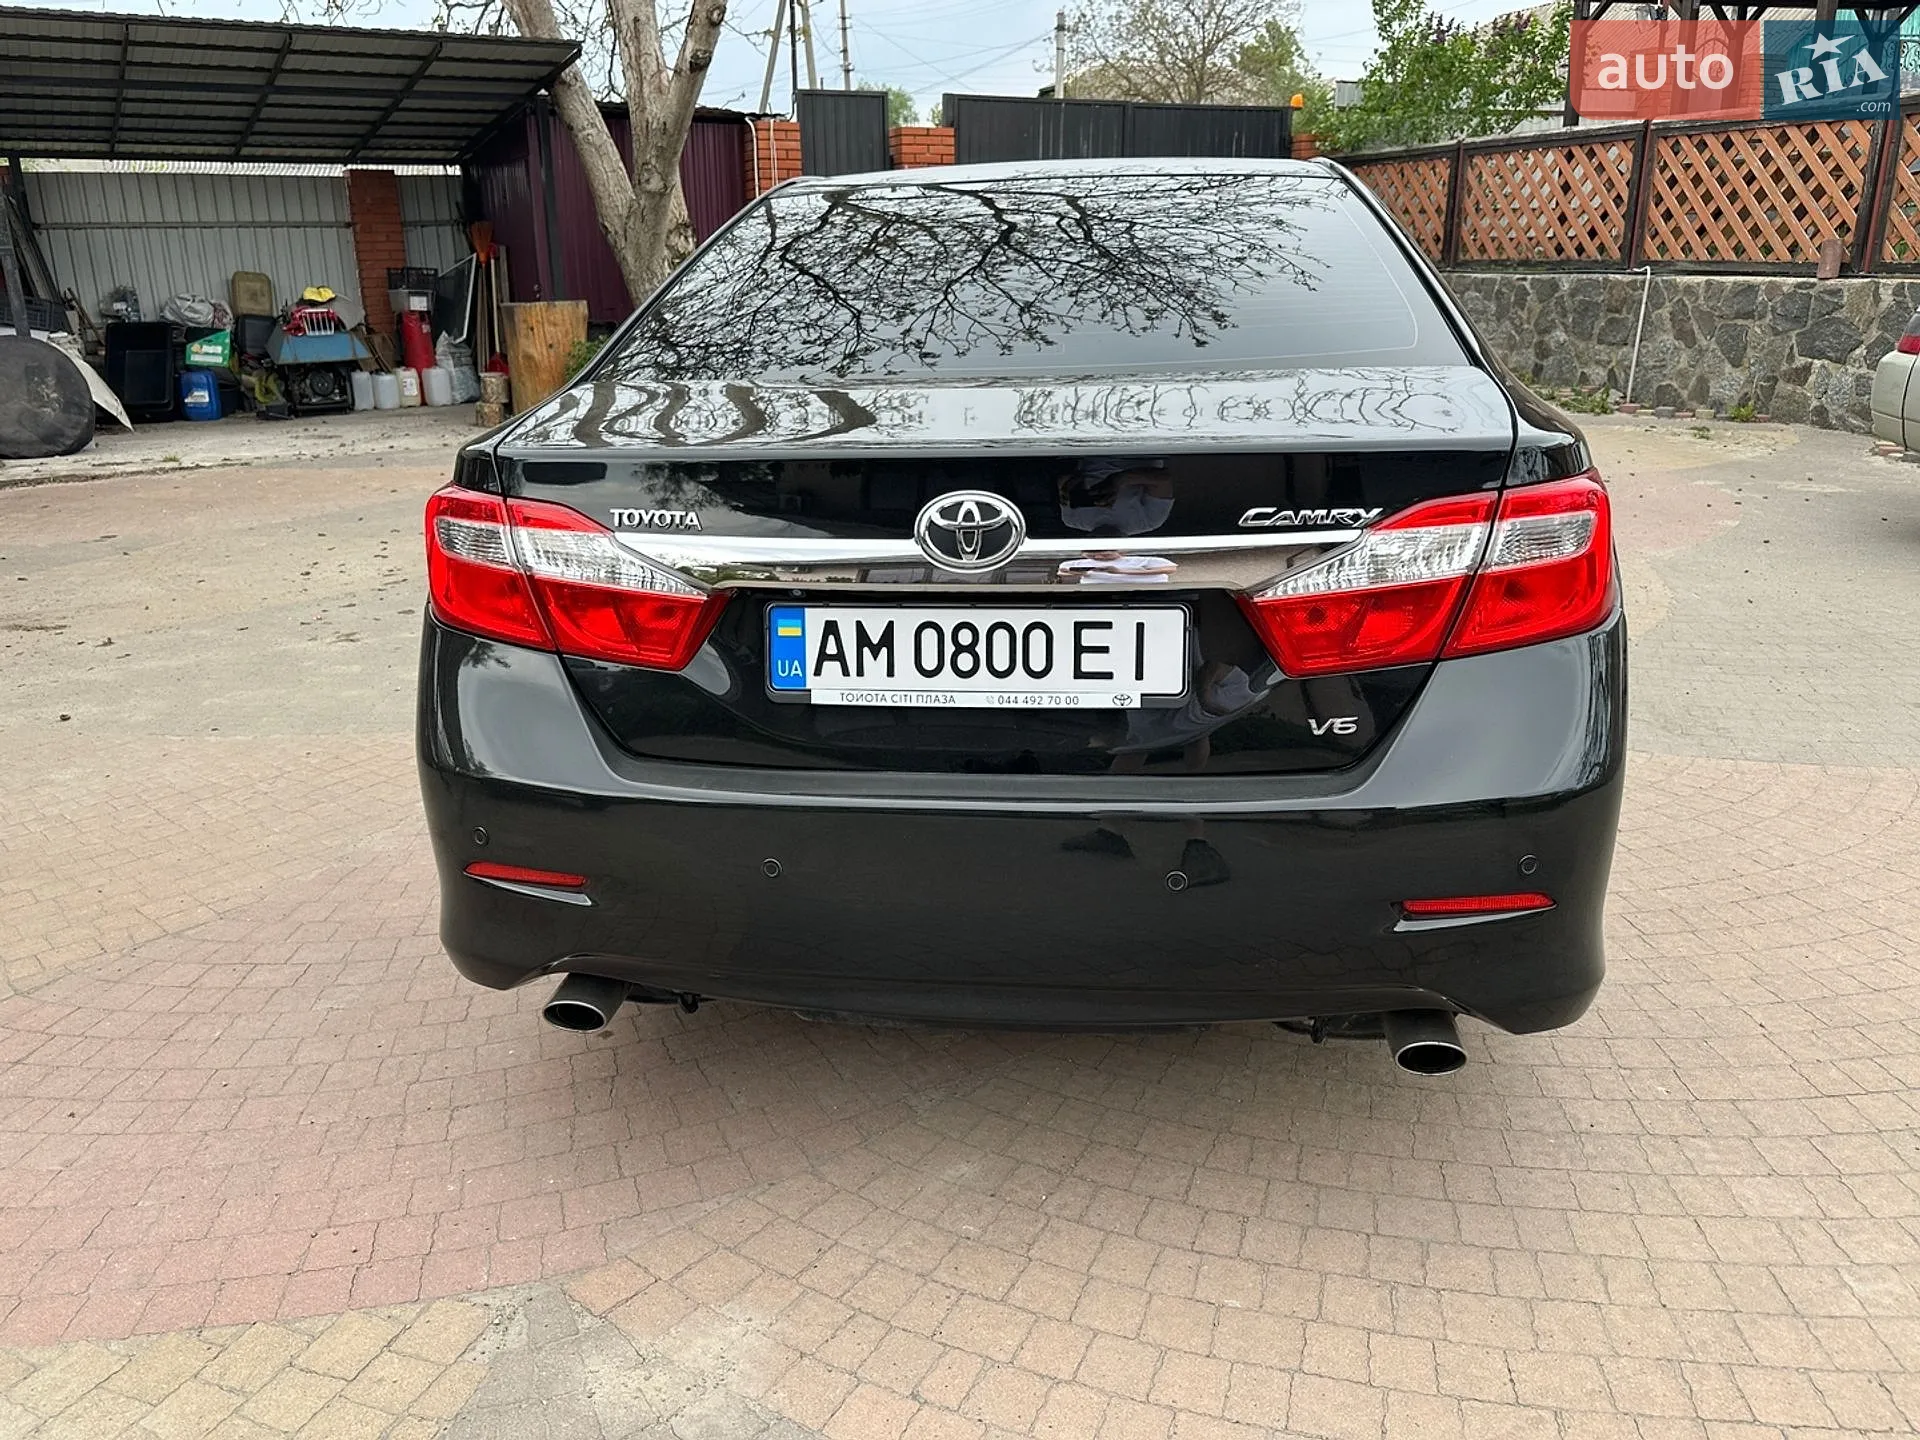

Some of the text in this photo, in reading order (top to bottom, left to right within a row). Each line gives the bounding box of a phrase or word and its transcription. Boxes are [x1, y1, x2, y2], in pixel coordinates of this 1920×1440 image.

[609, 508, 703, 531] TOYOTA
[1238, 507, 1383, 527] CAMRY
[813, 619, 1145, 681] AM 0800 EI
[777, 659, 803, 677] UA
[997, 695, 1080, 705] 044 492 70 00
[1306, 716, 1359, 736] V6
